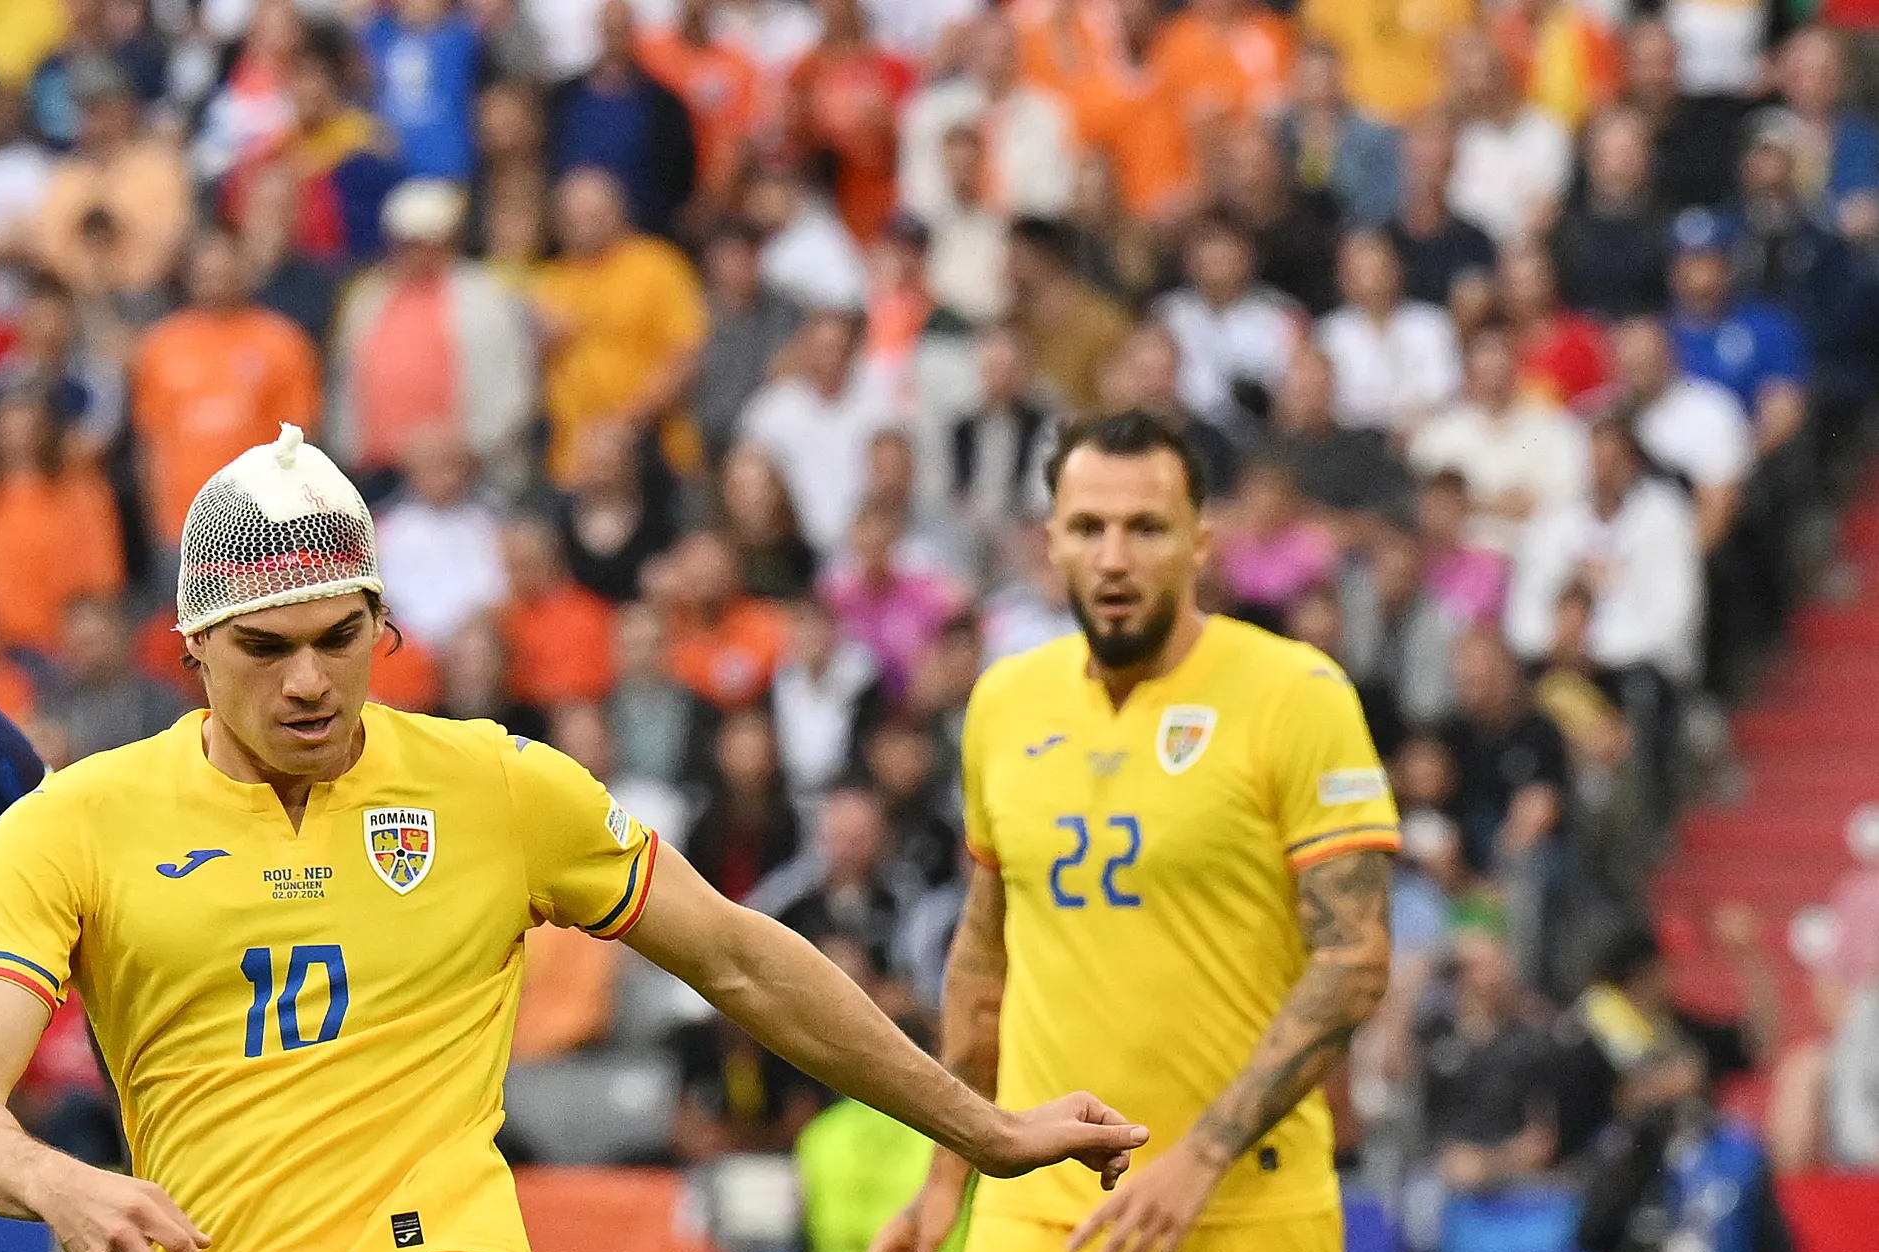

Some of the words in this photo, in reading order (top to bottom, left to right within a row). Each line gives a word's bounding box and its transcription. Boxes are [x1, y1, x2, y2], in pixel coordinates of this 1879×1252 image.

[370, 809, 428, 827] ROMÂNIA
[1048, 816, 1142, 908] 22
[263, 868, 292, 882] ROU
[304, 866, 333, 880] NED
[272, 890, 325, 899] 02.07.2024
[240, 944, 350, 1058] 10
